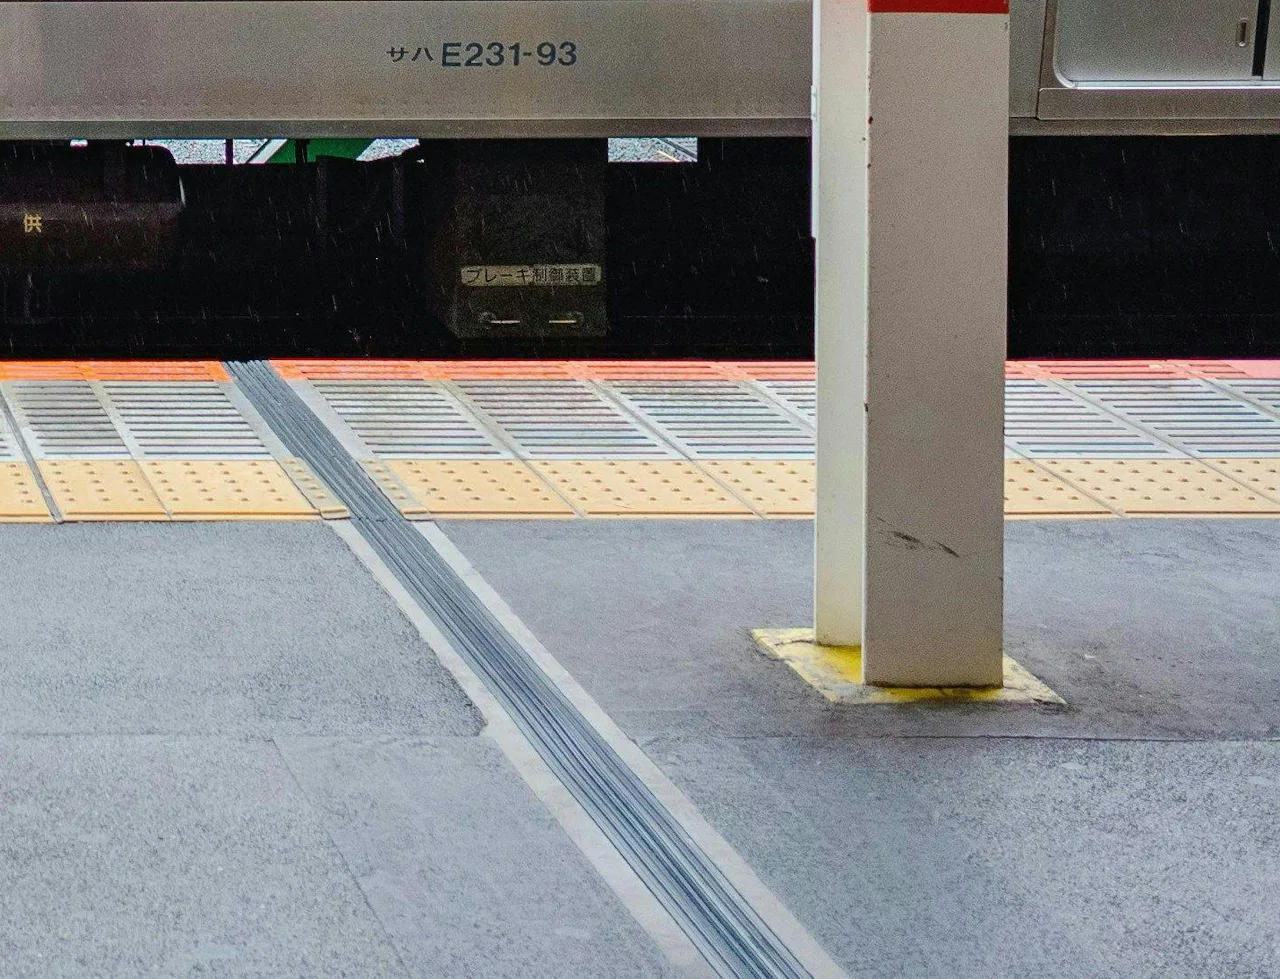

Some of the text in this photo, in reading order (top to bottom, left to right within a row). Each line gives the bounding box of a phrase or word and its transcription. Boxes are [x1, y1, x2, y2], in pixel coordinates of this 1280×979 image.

[441, 42, 577, 67] E231-93
[24, 213, 42, 233] 供
[466, 267, 596, 284] ブレーキ制御装置
